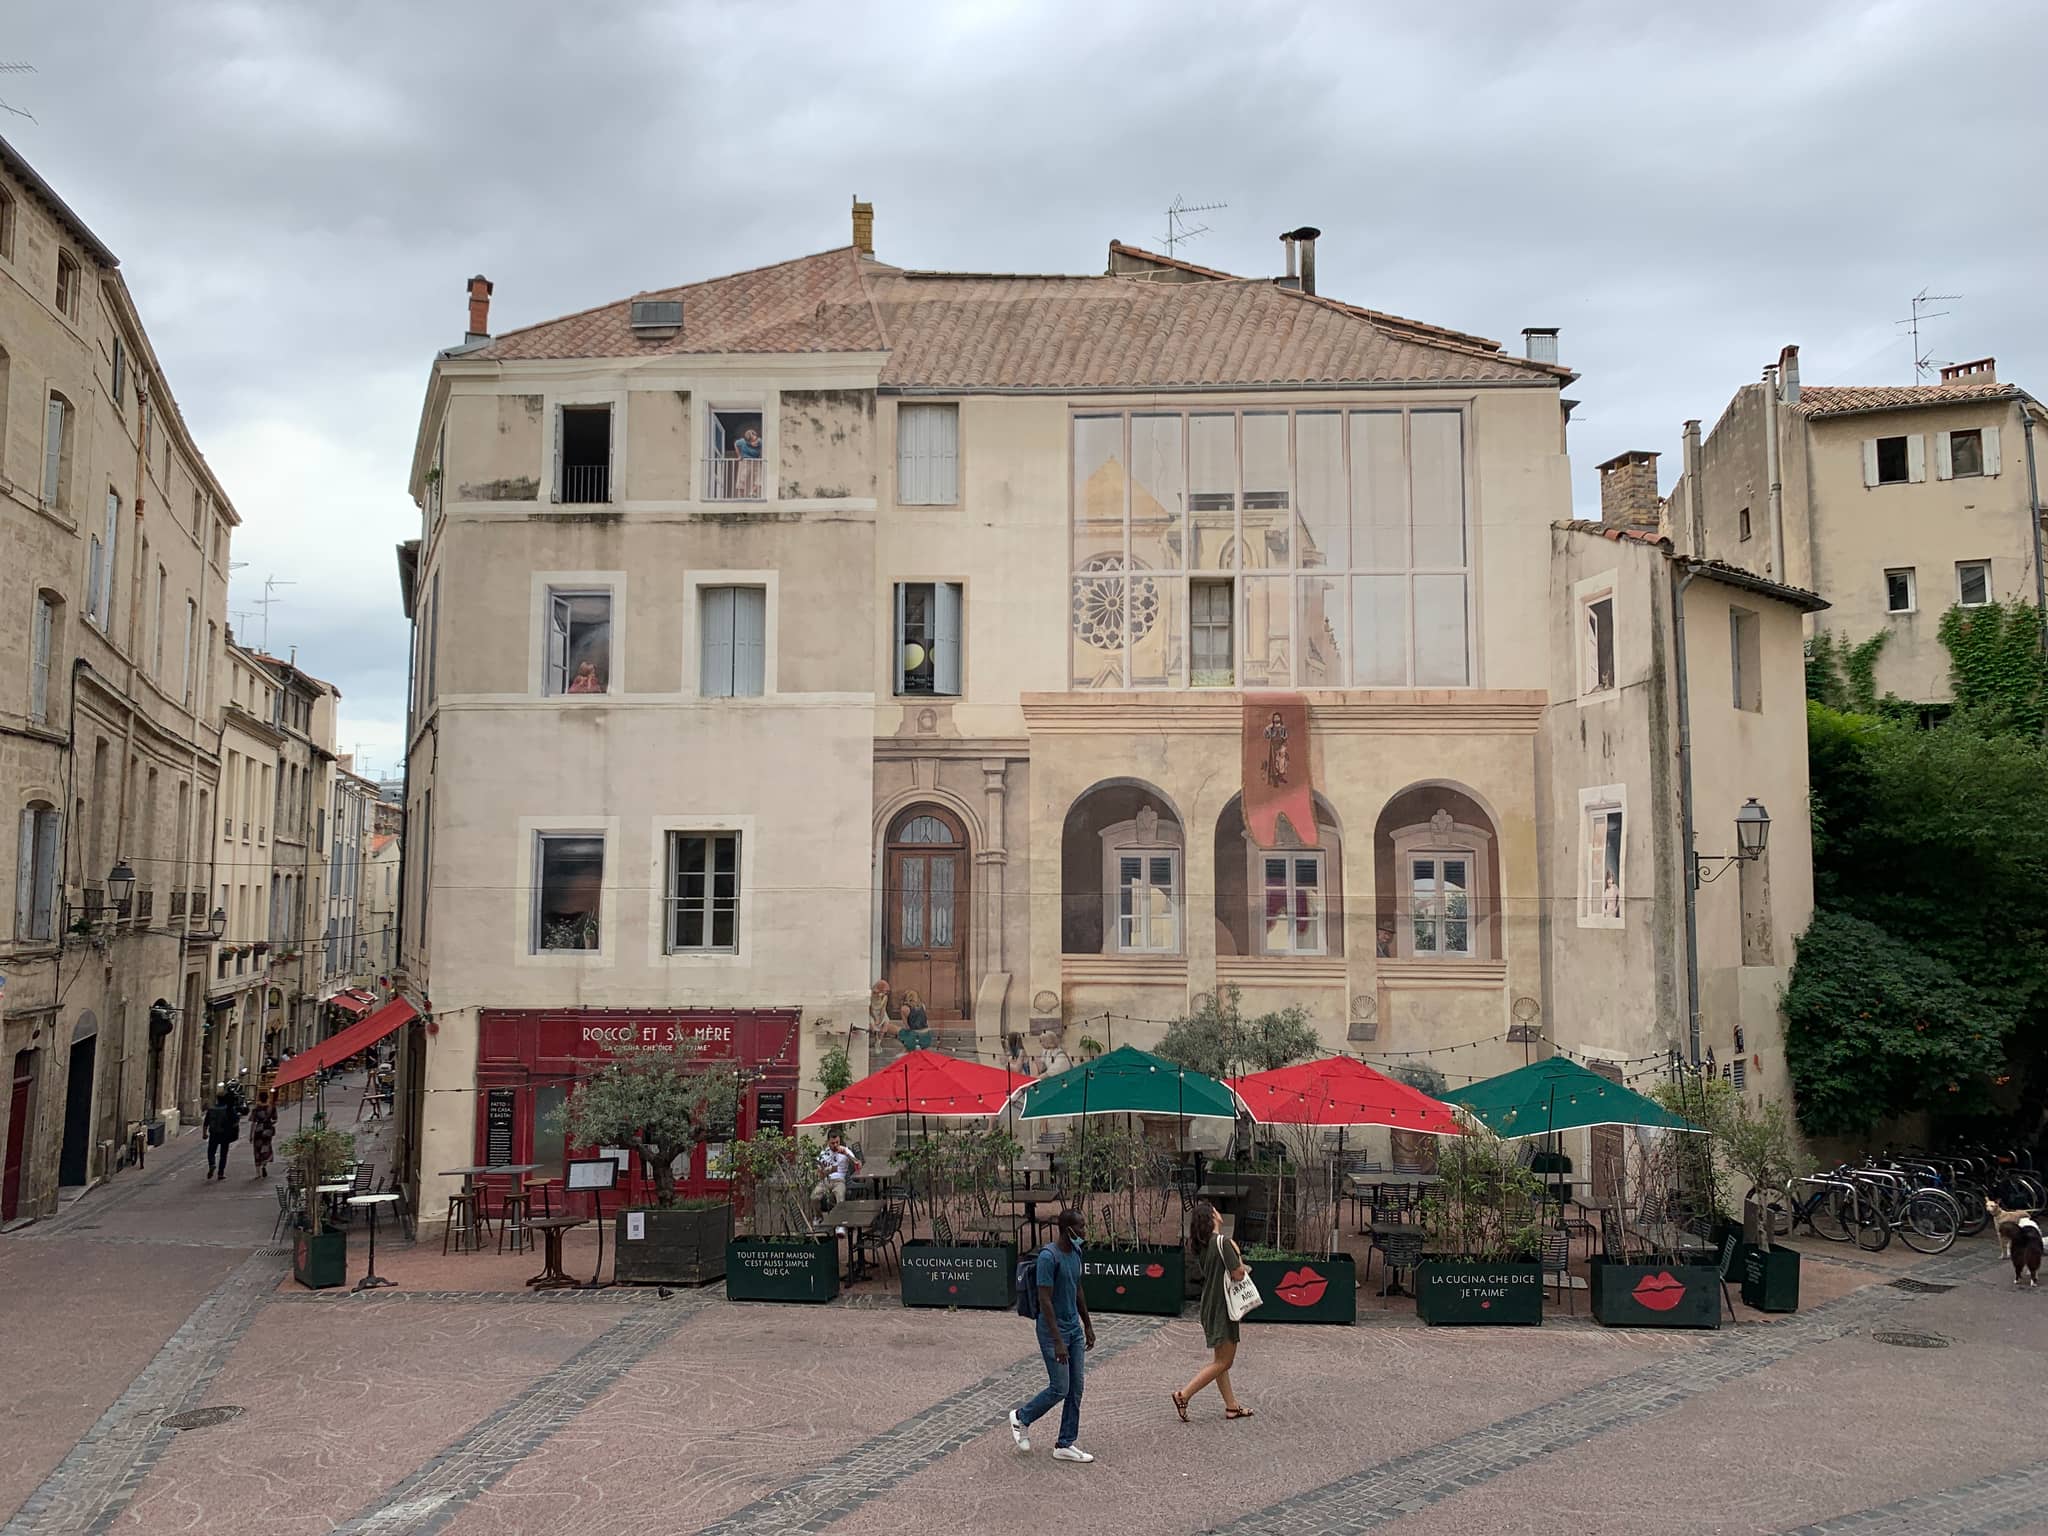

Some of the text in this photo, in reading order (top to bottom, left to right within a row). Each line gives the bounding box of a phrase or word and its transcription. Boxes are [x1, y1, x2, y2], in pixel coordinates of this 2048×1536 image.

[583, 1024, 731, 1041] ROCCO ET SA MÈRE
[736, 1251, 755, 1259] TOUT
[757, 1251, 768, 1259] EST
[770, 1251, 784, 1259] FAIT
[763, 1260, 783, 1268] AUSSI
[785, 1260, 809, 1268] SIMPLE
[902, 1258, 998, 1268] LA CUCINA CHE DICE
[763, 1268, 778, 1276] QUE
[1095, 1263, 1140, 1276] T'AIME
[1432, 1275, 1535, 1284] LA CUCINA CHE DICE
